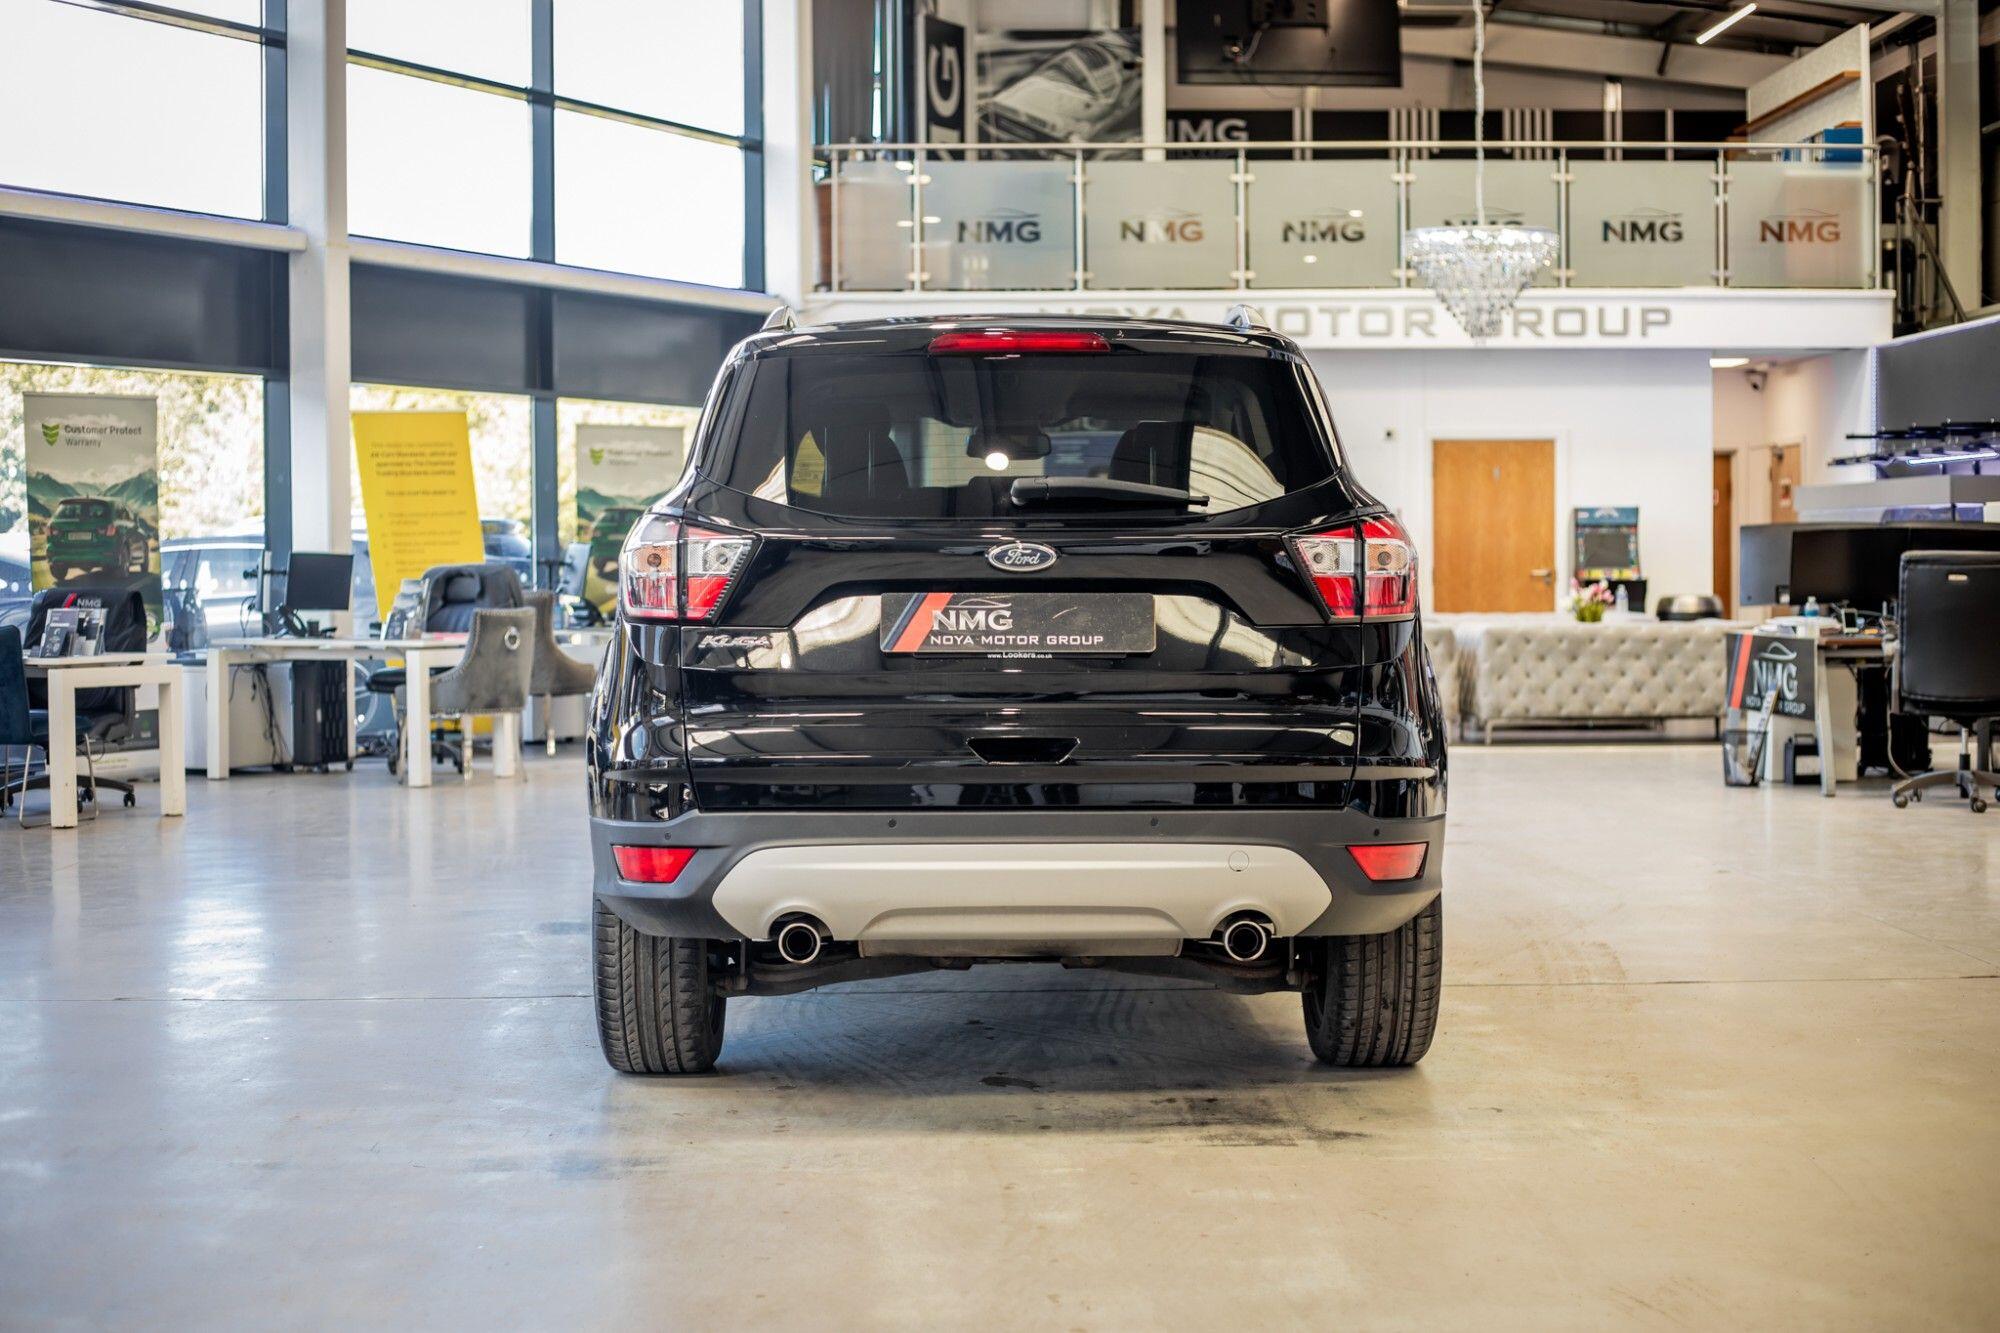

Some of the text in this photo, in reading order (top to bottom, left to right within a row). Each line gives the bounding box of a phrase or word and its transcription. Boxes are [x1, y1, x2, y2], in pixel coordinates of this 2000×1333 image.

[1167, 118, 1249, 142] MG
[957, 221, 1041, 243] NMG
[1120, 221, 1204, 243] NMG
[1282, 221, 1366, 243] NMG
[1602, 220, 1684, 243] NMG
[1759, 220, 1841, 243] NMG
[1227, 307, 1438, 338] OTOR
[1476, 307, 1671, 338] ROUP
[64, 424, 142, 435] Customer Protect
[65, 438, 101, 448] Warranty
[1003, 548, 1040, 565] Ford
[77, 598, 102, 608] NMG
[931, 609, 1013, 631] NMG
[930, 635, 1104, 645] NOYA MOTOR GROUP
